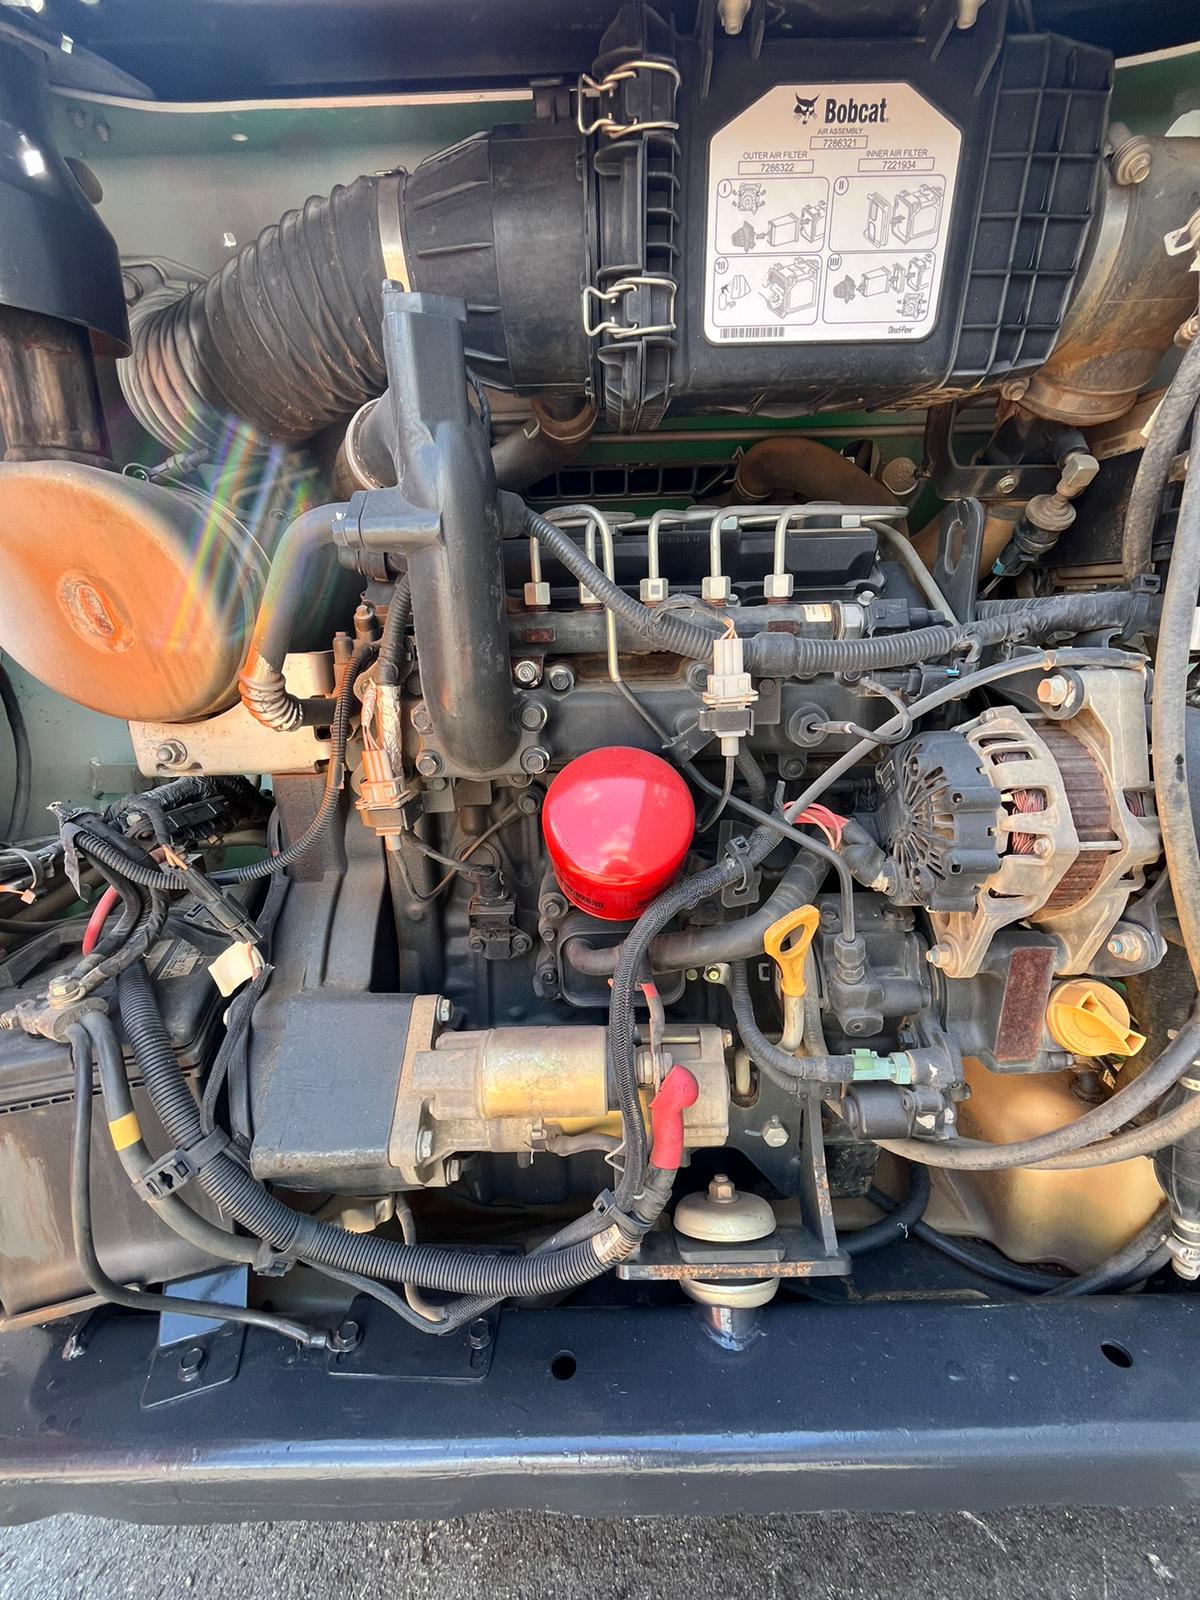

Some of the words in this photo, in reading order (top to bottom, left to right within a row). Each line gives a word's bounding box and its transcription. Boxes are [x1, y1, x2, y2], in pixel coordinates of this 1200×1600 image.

[825, 98, 887, 124] Bobcat
[829, 127, 863, 135] ASSEMBLY
[823, 138, 857, 148] 7286321
[743, 151, 768, 160] OUTER
[769, 151, 781, 159] AIR
[783, 150, 808, 159] FILTER
[866, 149, 888, 158] INNER
[890, 149, 902, 157] AIR
[903, 148, 928, 157] FILTER
[761, 163, 795, 172] 7286322
[882, 160, 916, 170] 7221934
